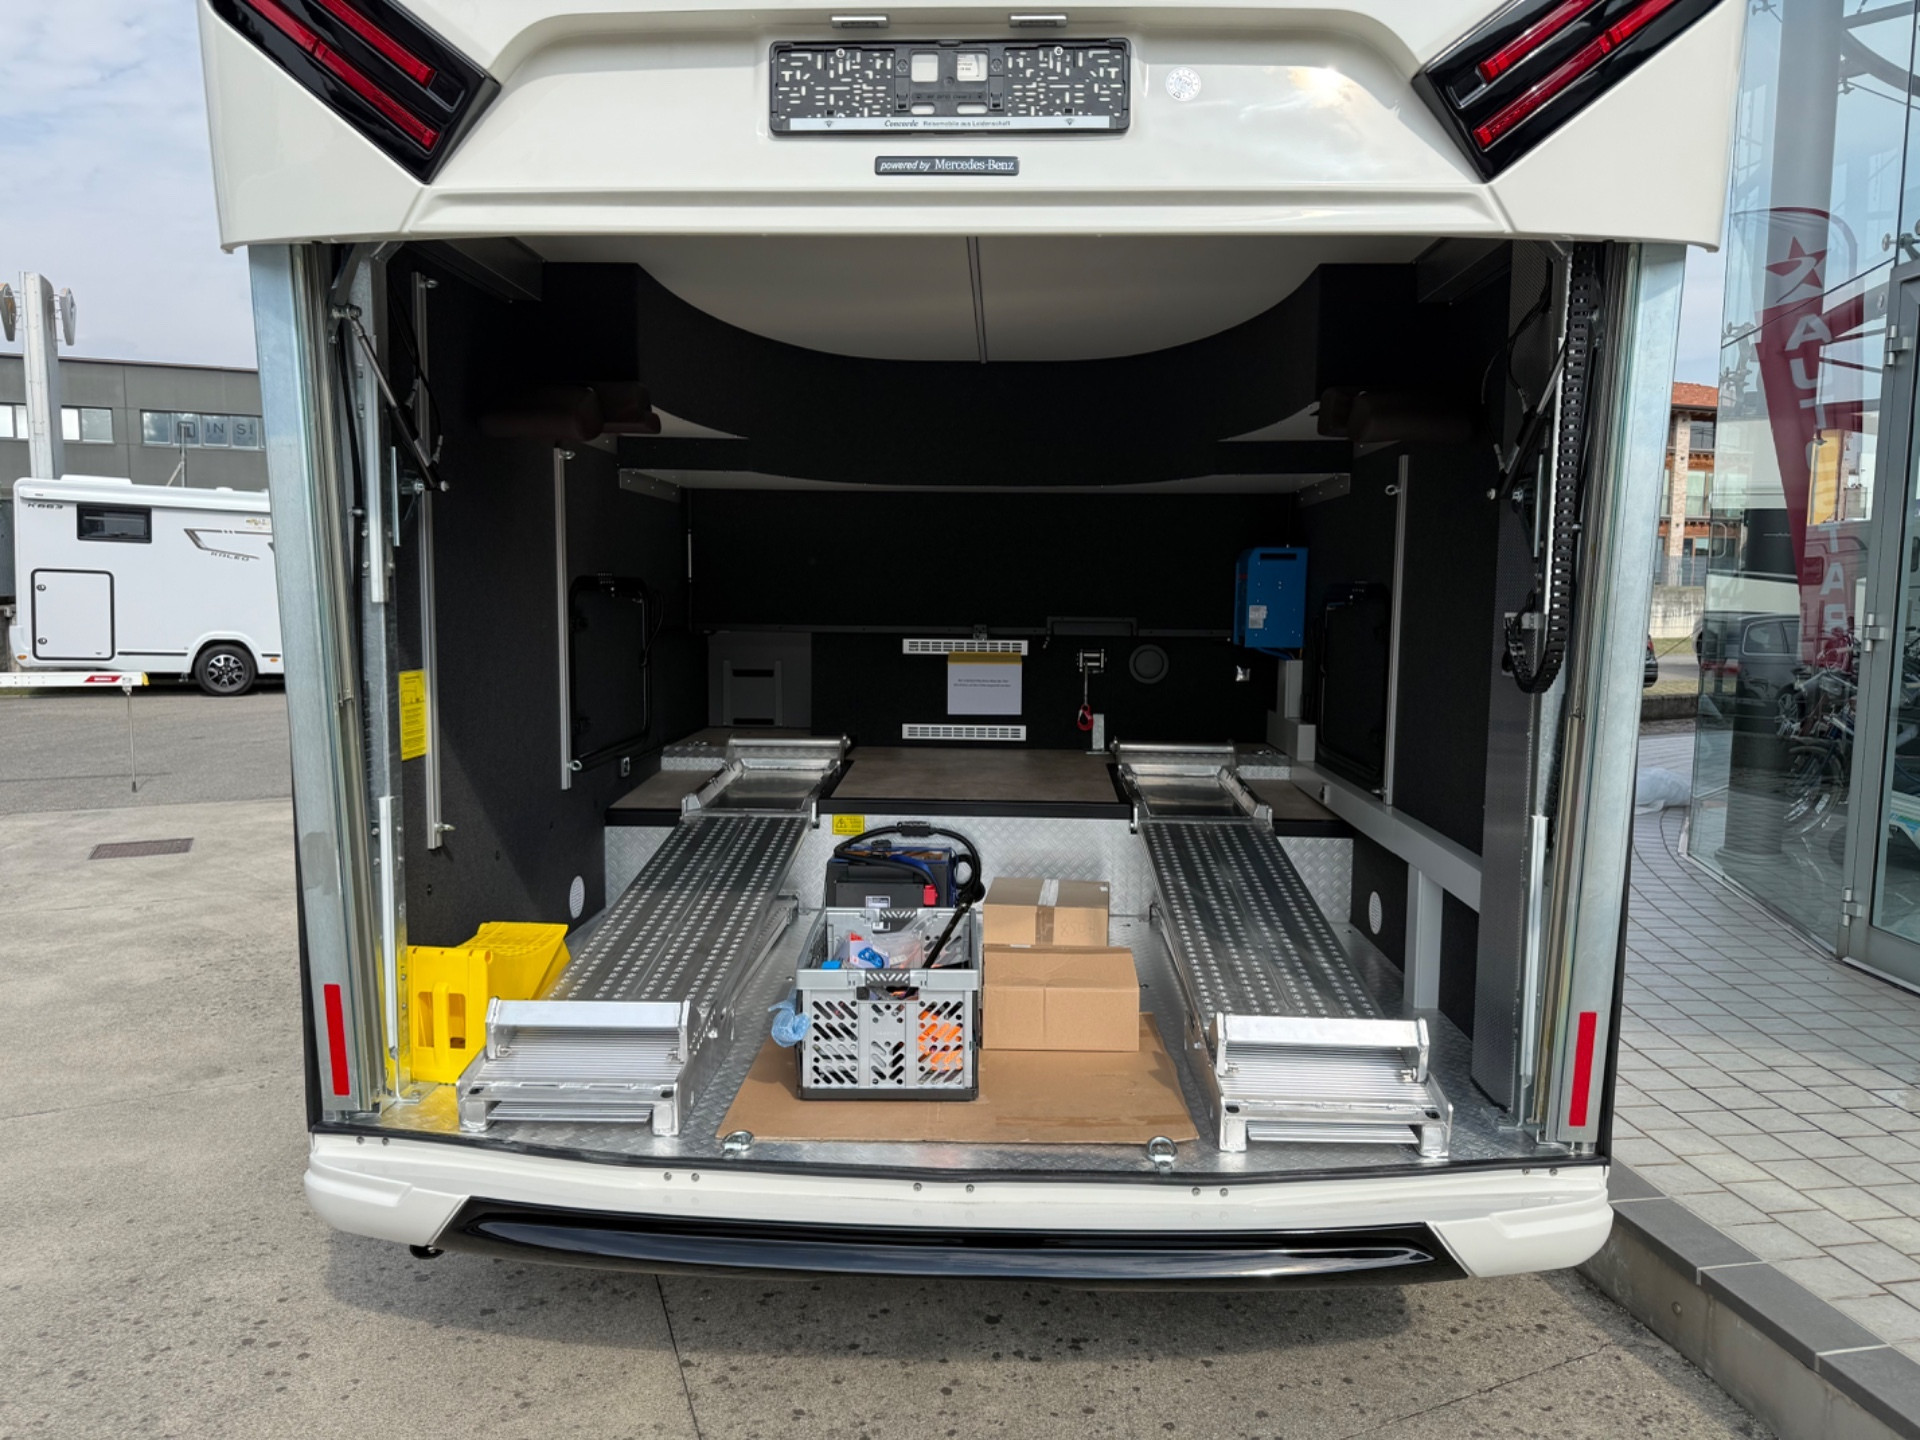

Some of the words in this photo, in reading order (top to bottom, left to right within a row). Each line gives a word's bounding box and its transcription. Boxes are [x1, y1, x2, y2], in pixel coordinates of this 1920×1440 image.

[884, 119, 919, 128] Concorde
[880, 160, 919, 171] powered
[920, 160, 931, 172] by
[935, 158, 1015, 170] Mercedes-Benz
